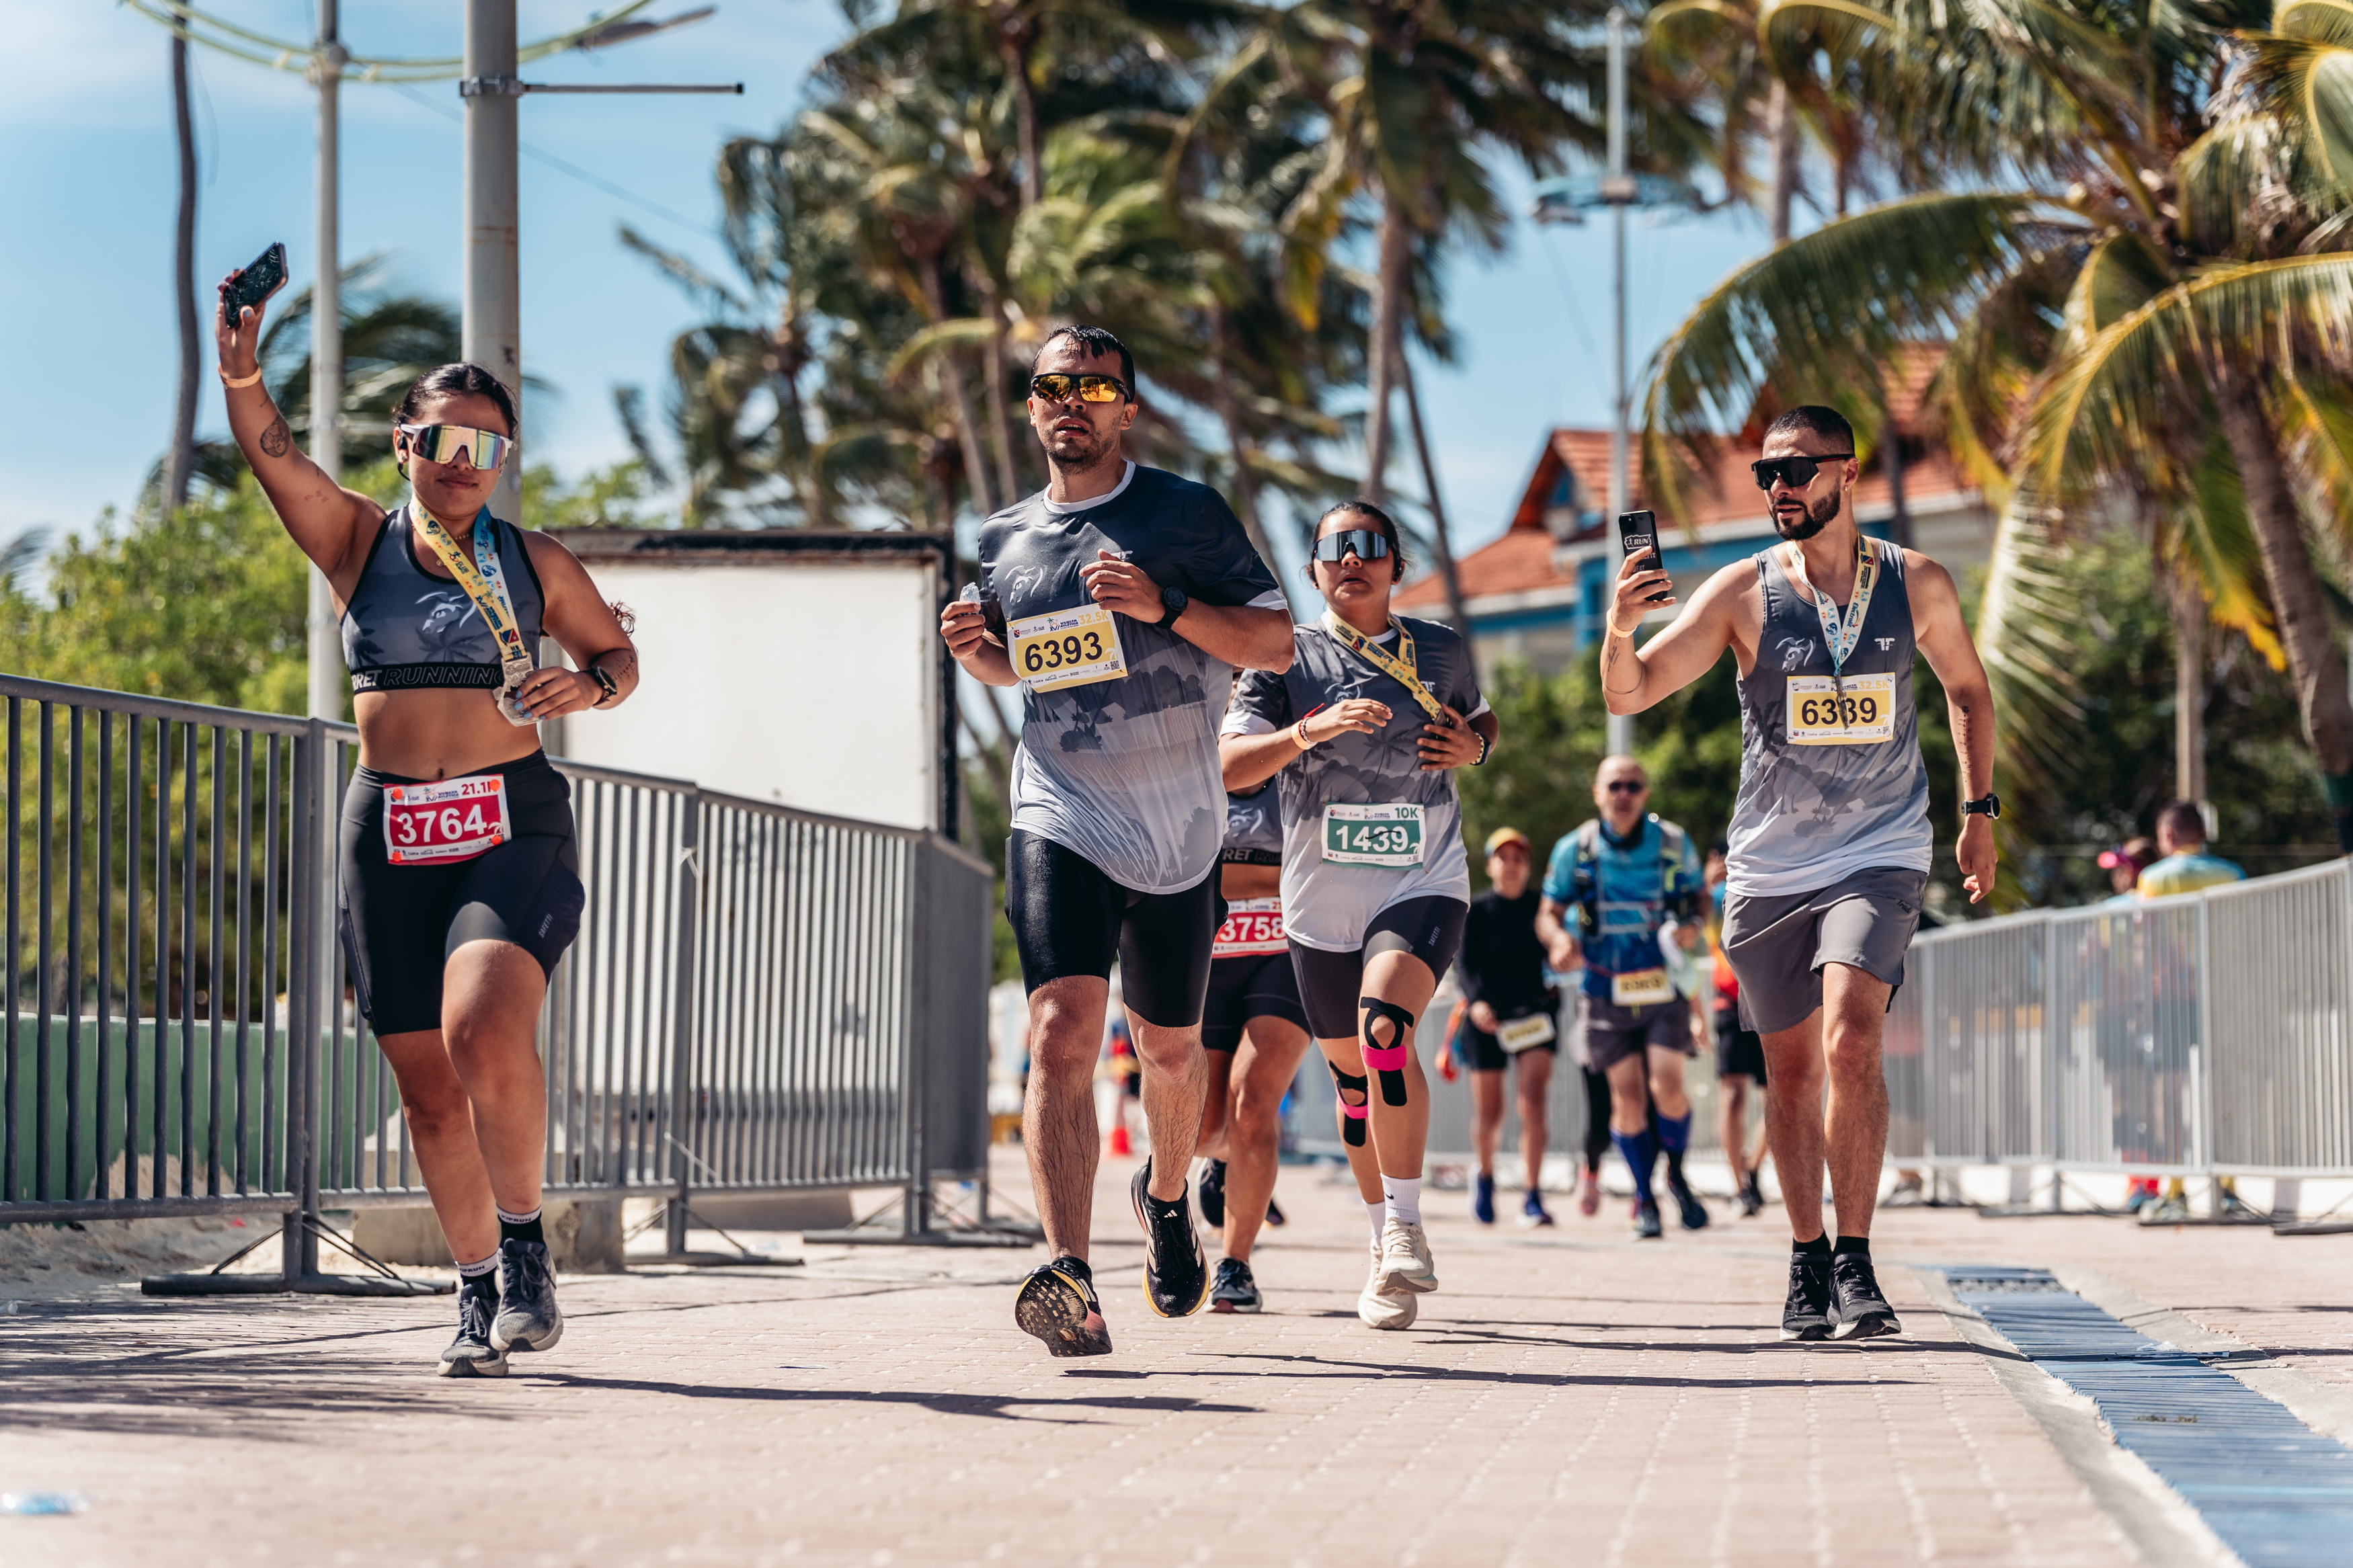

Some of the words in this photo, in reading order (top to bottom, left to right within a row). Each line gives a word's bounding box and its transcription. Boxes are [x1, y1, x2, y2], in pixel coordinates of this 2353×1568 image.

[458, 560, 469, 573] CLUB
[1078, 611, 1108, 625] 32.5K
[1847, 602, 1859, 627] Electrolit
[1025, 632, 1103, 672] 6393
[1859, 680, 1889, 690] 32.5K
[1395, 807, 1419, 819] 10K
[397, 804, 487, 844] 3764
[1336, 825, 1408, 852] 1439
[1222, 849, 1253, 861] RET
[539, 913, 553, 938] SAFETTI
[1220, 917, 1285, 941] 3758
[1429, 926, 1441, 946] SAFETTI
[501, 1214, 532, 1223] KIPRUN
